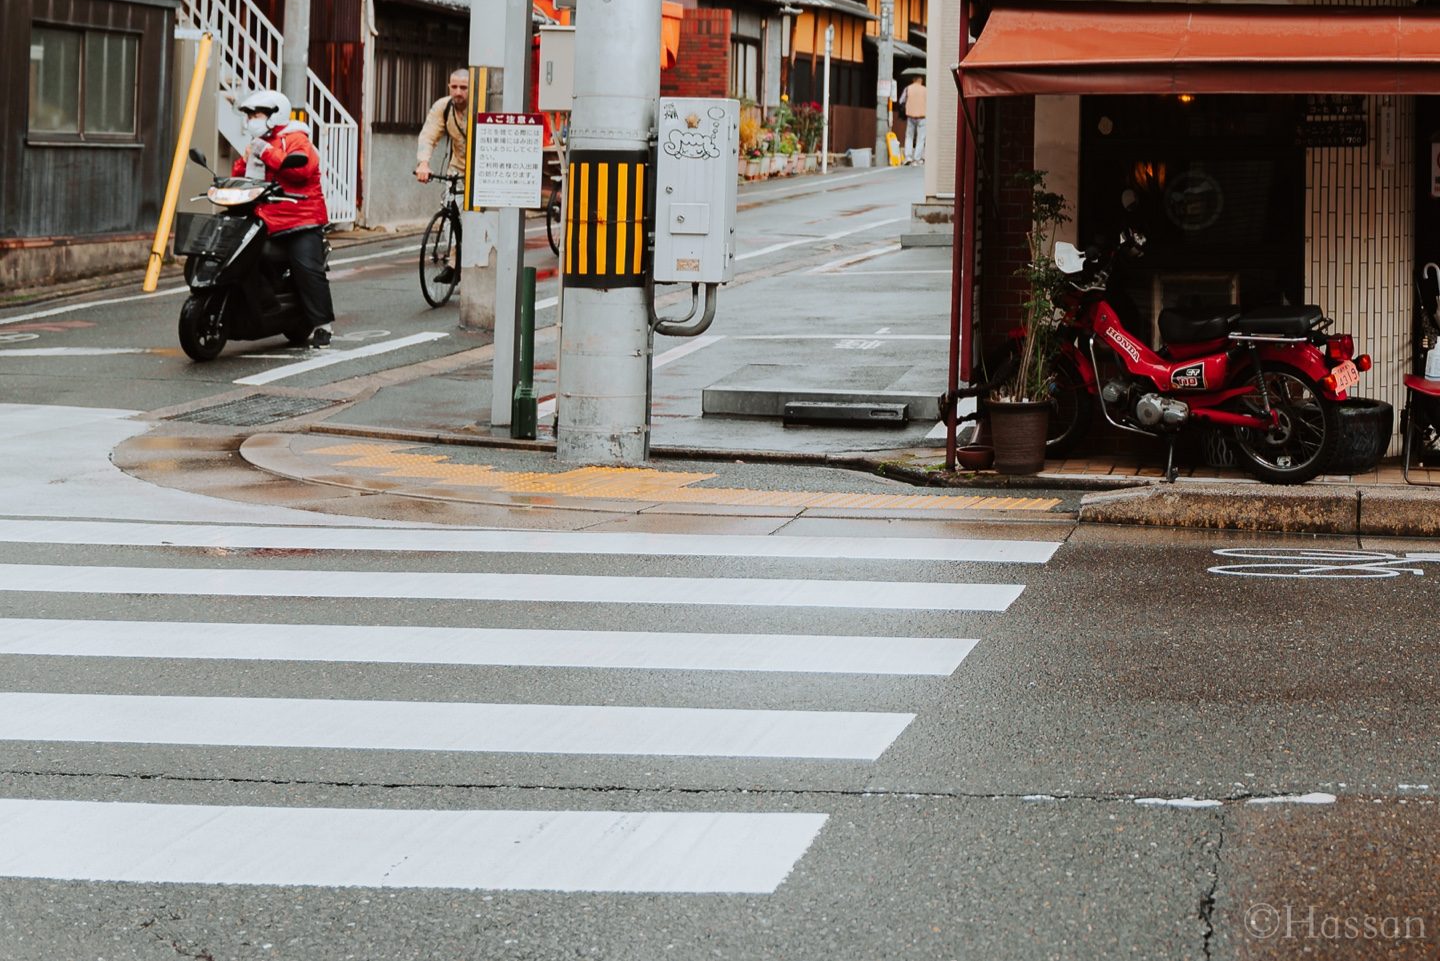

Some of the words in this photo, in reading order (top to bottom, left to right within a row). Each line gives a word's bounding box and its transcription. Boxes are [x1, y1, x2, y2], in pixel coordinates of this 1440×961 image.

[495, 115, 526, 124] ご注意
[1107, 327, 1140, 362] HONDA
[1177, 377, 1198, 386] 110
